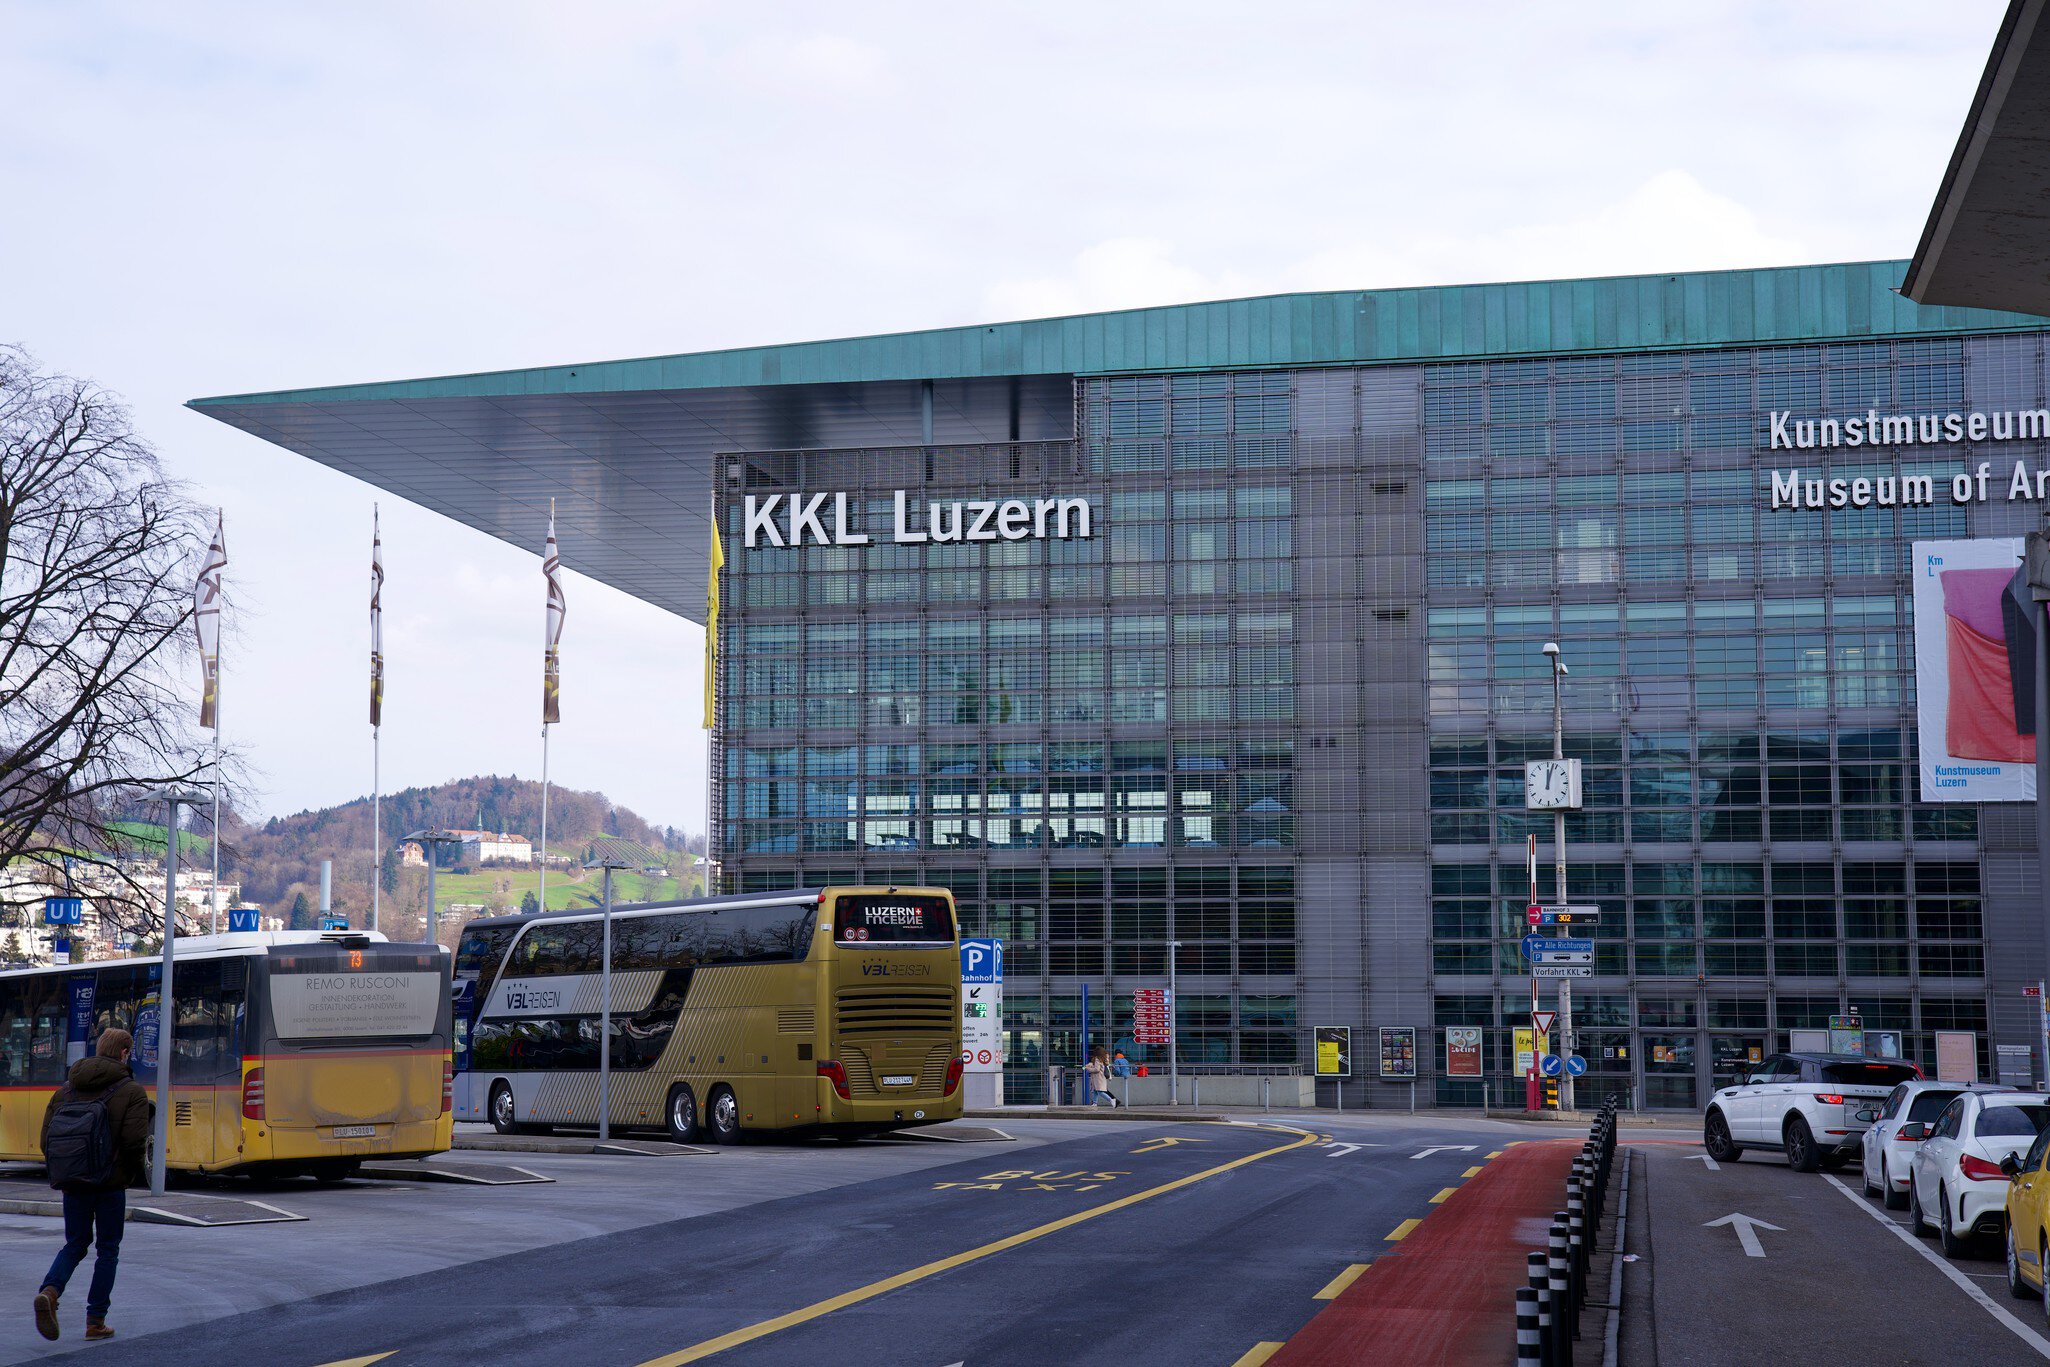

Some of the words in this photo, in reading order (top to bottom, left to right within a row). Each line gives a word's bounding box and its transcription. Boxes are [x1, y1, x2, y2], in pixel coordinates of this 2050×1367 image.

[1770, 409, 2050, 449] Kunstmuseum
[1771, 469, 1933, 508] Museum
[1952, 462, 1990, 502] of
[744, 492, 869, 547] KKL
[894, 490, 1090, 542] Luzern
[1928, 555, 1943, 565] Km
[1928, 567, 1934, 576] L
[1935, 765, 2001, 775] Kunstmuseum
[1936, 777, 1967, 787] Luzern
[50, 903, 64, 919] U
[71, 903, 79, 919] U
[865, 907, 915, 916] LUZERN
[233, 913, 245, 928] V
[250, 913, 257, 928] V
[1558, 914, 1571, 922] 302
[1558, 941, 1591, 951] Richtungen
[349, 950, 362, 968] 73
[968, 949, 983, 971] P
[306, 977, 345, 990] REMO
[350, 976, 409, 989] RUSCONI
[321, 994, 395, 1002] INNENDEKORATION
[308, 1003, 357, 1011] GESTALTUNG
[364, 1002, 407, 1010] HANDWERK
[976, 1170, 1132, 1181] BUS
[931, 1182, 1103, 1191] TAXI
